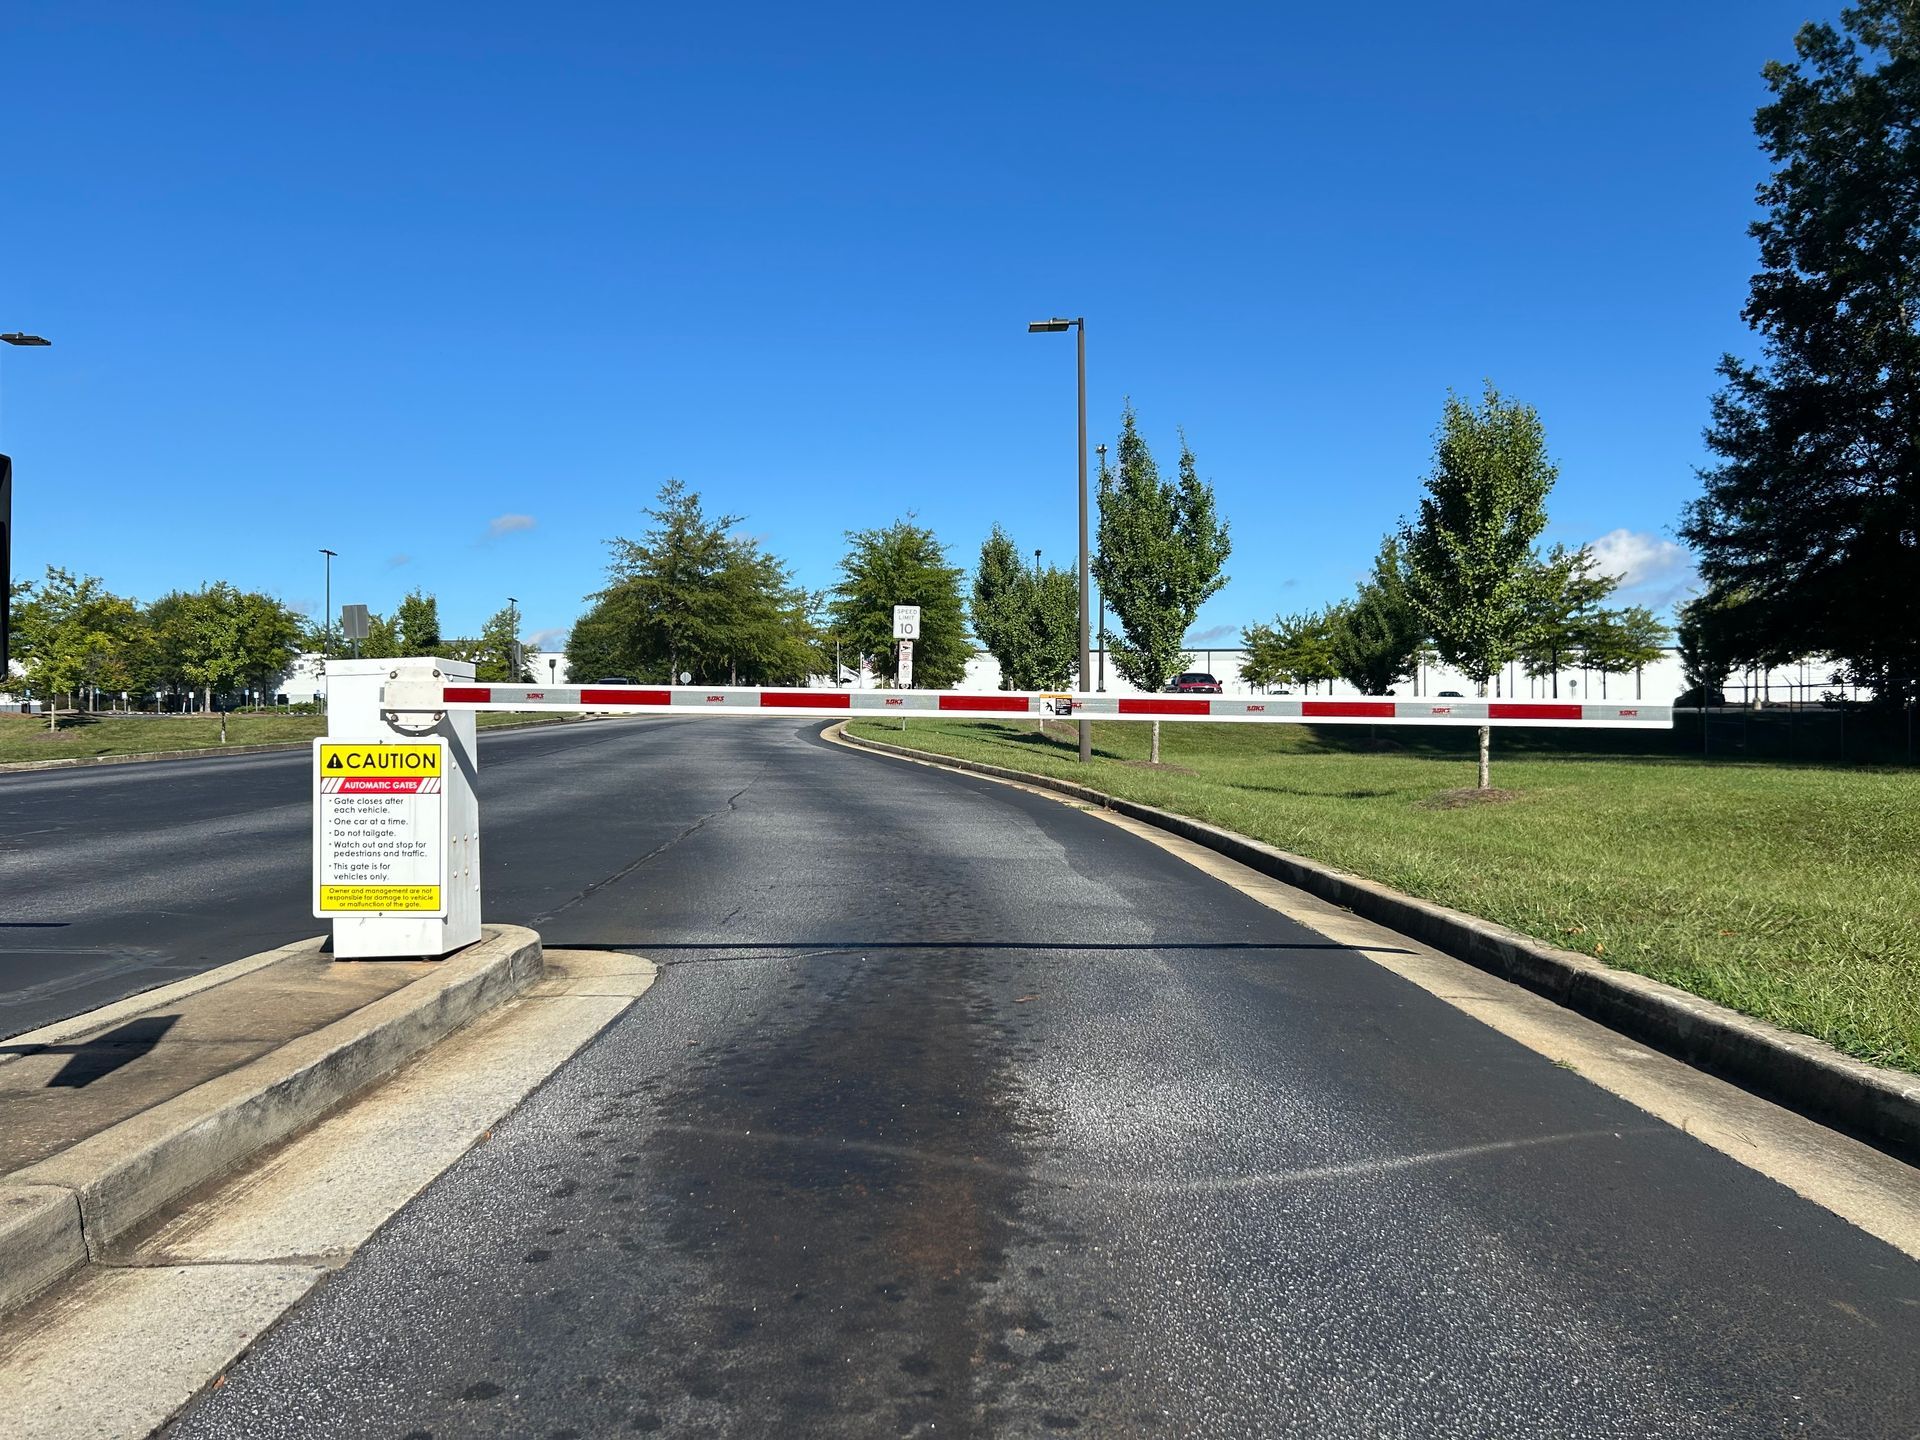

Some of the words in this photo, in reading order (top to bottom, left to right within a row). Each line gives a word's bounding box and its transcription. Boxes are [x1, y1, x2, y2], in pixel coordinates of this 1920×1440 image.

[900, 623, 913, 634] 10
[346, 753, 435, 768] CAUTION
[363, 830, 396, 838] tailgate.
